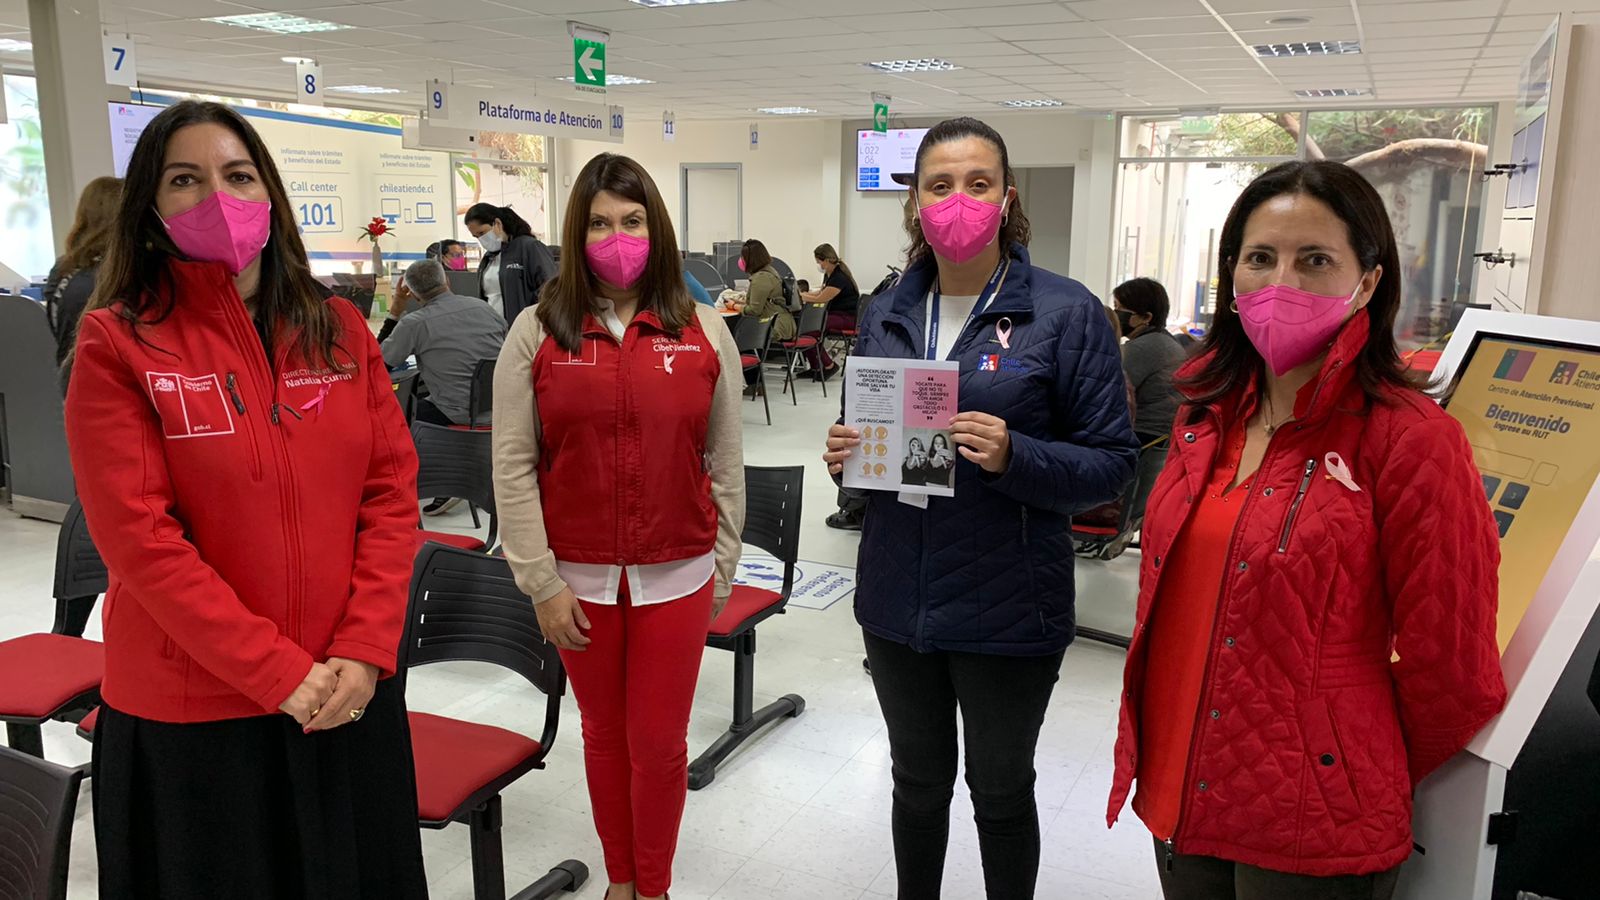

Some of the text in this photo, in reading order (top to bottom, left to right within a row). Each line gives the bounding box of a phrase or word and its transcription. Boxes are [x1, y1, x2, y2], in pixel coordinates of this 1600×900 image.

[112, 47, 125, 70] 7
[304, 74, 316, 94] 8
[433, 91, 443, 109] 9
[479, 101, 603, 130] Plataforma de Atención
[612, 114, 623, 129] 10
[664, 121, 674, 134] 11
[290, 181, 337, 192] Call center
[379, 183, 434, 194] chileatiende.cl
[299, 203, 336, 226] 101
[285, 375, 321, 388] Natalia
[1488, 384, 1595, 410] Centro de Atención Previsional
[1485, 403, 1571, 434] Bienvenido
[1493, 421, 1550, 440] Ingrese su RUT
